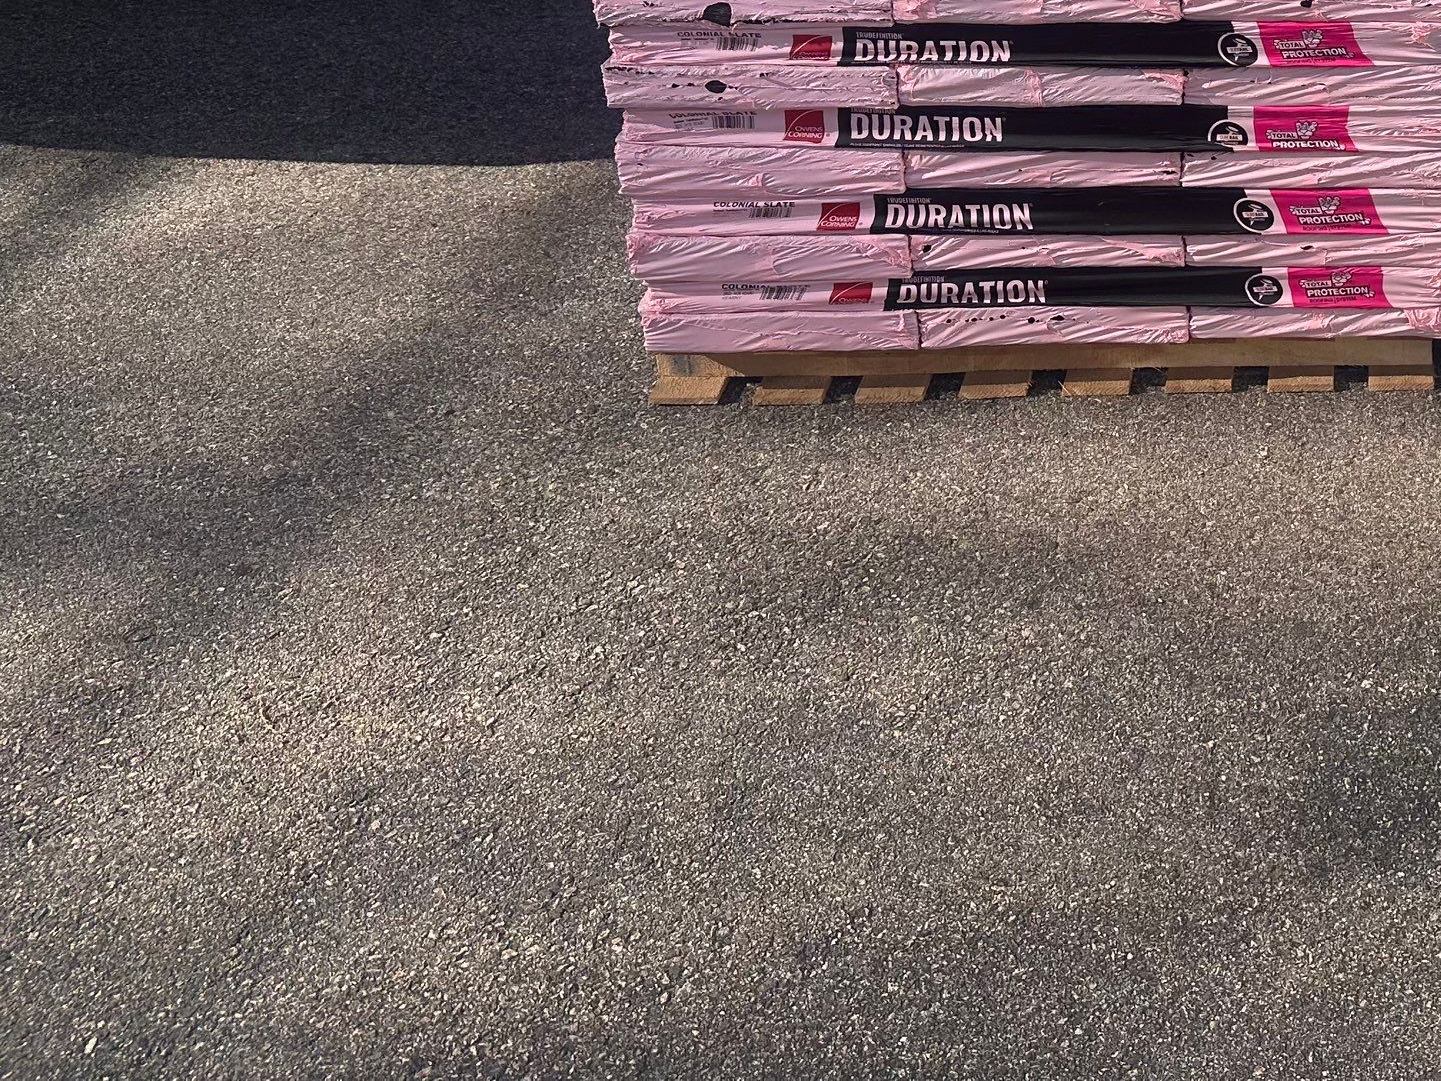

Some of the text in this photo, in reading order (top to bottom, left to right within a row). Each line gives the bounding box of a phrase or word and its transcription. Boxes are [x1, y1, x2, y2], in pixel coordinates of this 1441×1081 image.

[854, 39, 1011, 62] DURATION
[1282, 48, 1347, 58] PROTECTION
[850, 113, 1003, 142] DURATION
[1272, 140, 1338, 149] PROTECTION
[884, 203, 1034, 230] DURATION
[1300, 214, 1363, 224] PROTECTION
[897, 280, 1046, 304] DURATION
[1307, 287, 1368, 297] PROTECTION
